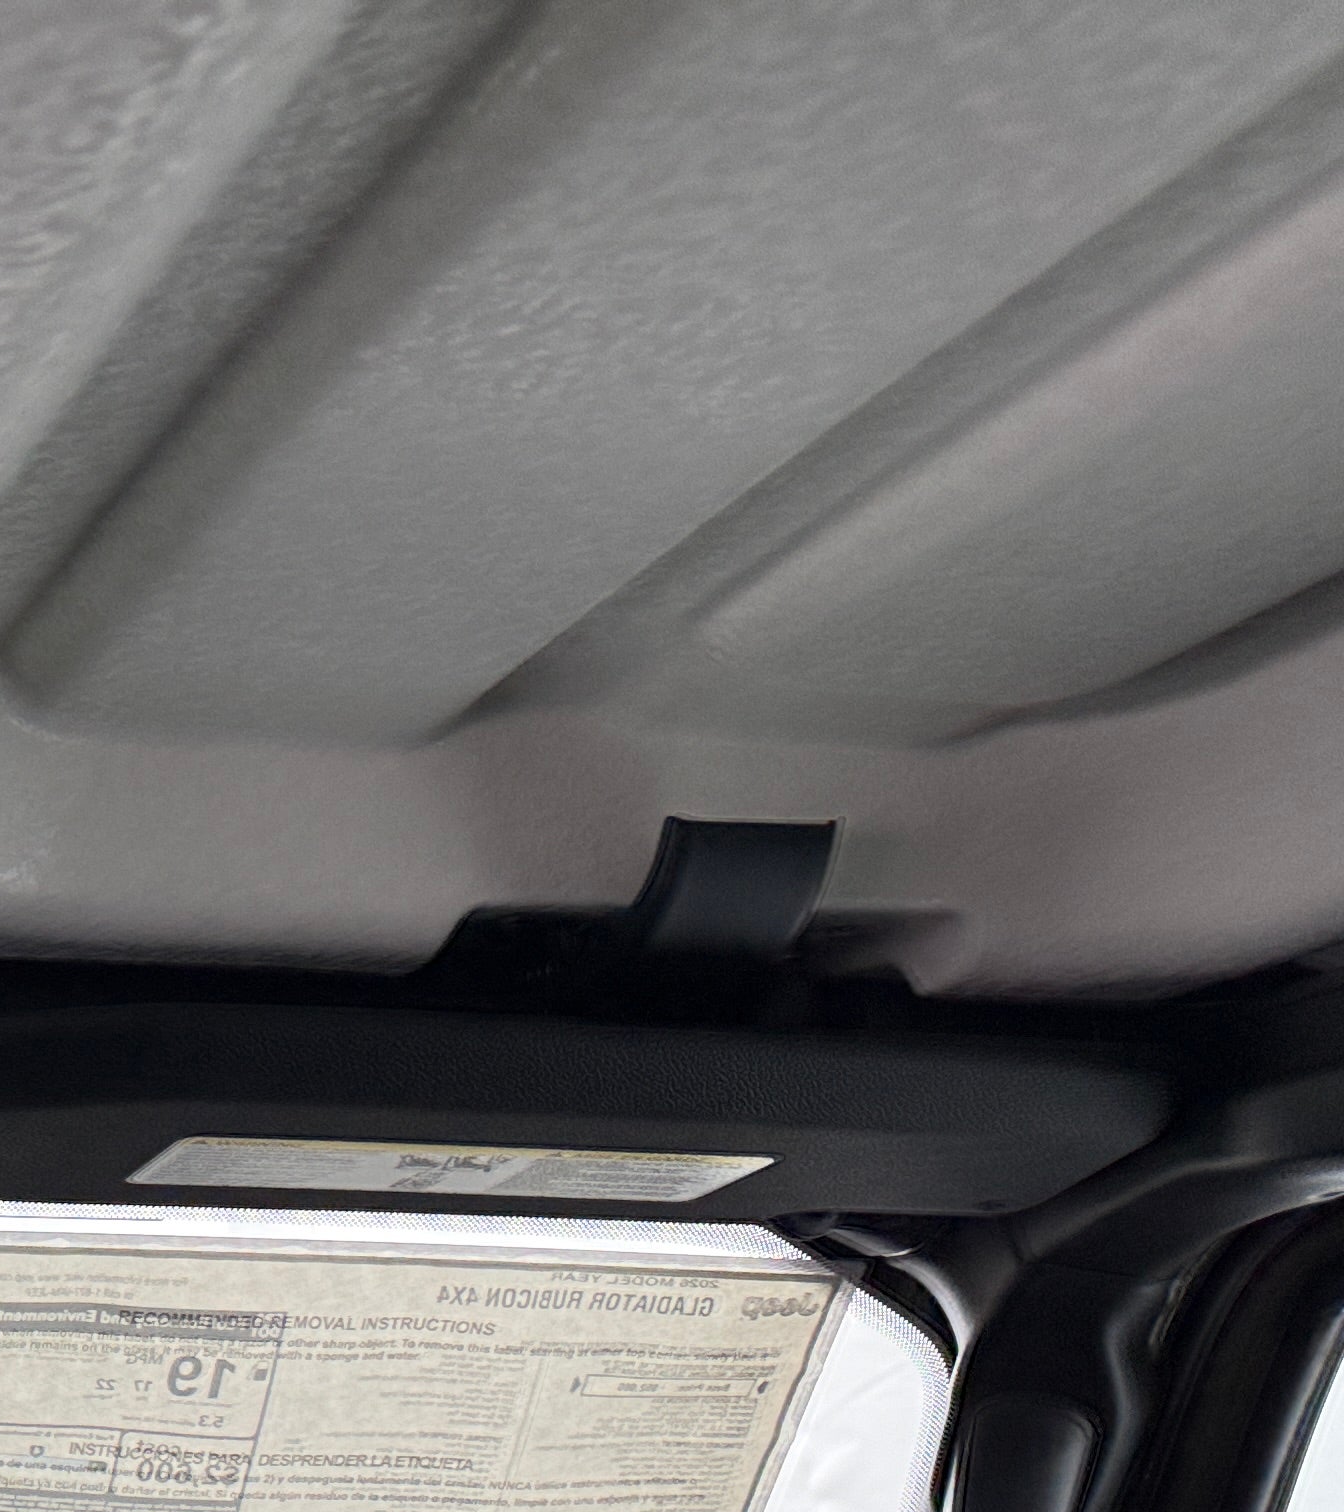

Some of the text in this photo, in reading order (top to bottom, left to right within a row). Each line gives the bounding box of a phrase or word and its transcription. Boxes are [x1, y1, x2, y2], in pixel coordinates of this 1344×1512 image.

[270, 1313, 356, 1331] REMOVAL
[361, 1315, 497, 1337] INSTRUCTIONS
[30, 1341, 79, 1351] remains
[287, 1339, 321, 1348] other
[323, 1340, 355, 1351] sharp
[418, 1341, 464, 1352] remove
[258, 1454, 369, 1468] DESPRENDER
[370, 1455, 393, 1468] LA
[395, 1455, 476, 1472] ETIQUETA
[488, 1480, 532, 1491] NUNCA
